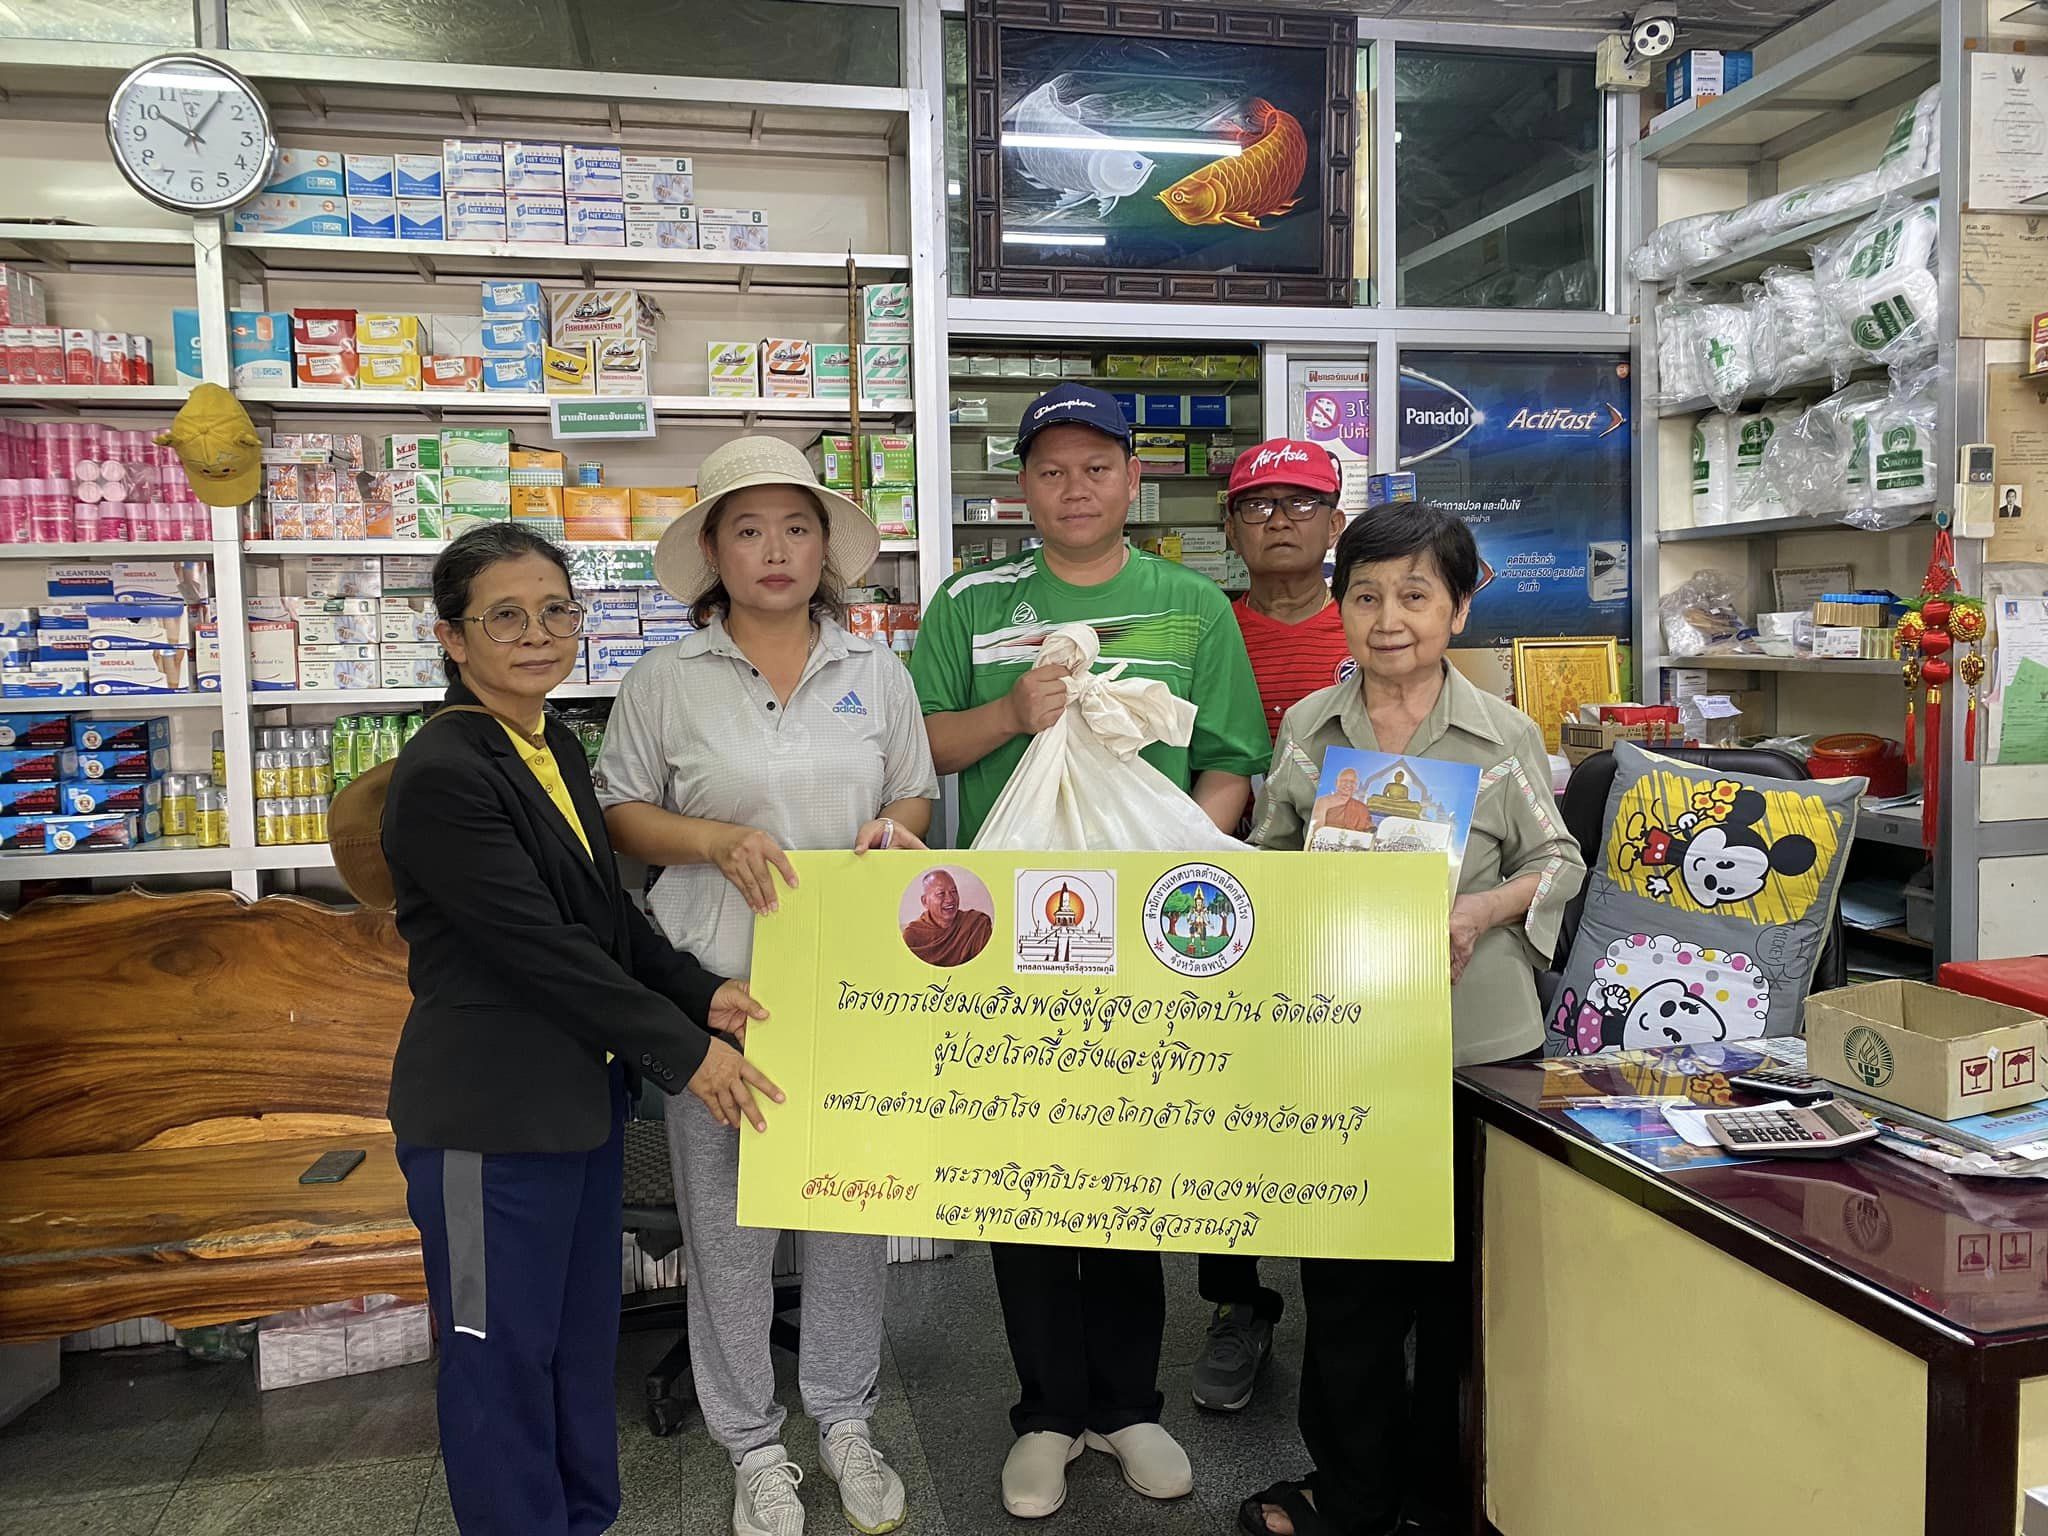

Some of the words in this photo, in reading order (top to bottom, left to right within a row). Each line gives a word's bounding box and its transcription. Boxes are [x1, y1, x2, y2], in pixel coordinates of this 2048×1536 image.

[139, 104, 161, 120] 10
[231, 105, 243, 121] 2
[133, 125, 147, 141] 9
[241, 131, 253, 147] 3
[142, 149, 154, 165] 8
[234, 154, 247, 169] 4
[163, 169, 175, 184] 7
[191, 177, 203, 192] 6
[217, 172, 229, 187] 5
[565, 322, 600, 332] FISHERMAN'S
[601, 323, 622, 332] FRIEND
[1033, 398, 1096, 420] Champion
[1346, 402, 1356, 418] 3
[1406, 408, 1468, 425] Panadol
[1508, 408, 1598, 430] ActiFast
[396, 443, 416, 456] M.16
[394, 478, 415, 491] M.16
[396, 514, 416, 526] M.16
[48, 634, 88, 642] KLEANTR
[832, 704, 868, 716] adidas
[1768, 928, 1790, 962] MICKEY
[1017, 962, 1114, 975] พุทธสถานลพบุรีศรีสุวรรณภูมิ
[1170, 954, 1228, 972] จังหวัดลพบุรี
[838, 976, 1265, 1036] โครงการเยี่ยมเสริมพลังผู้สูงอายุติดบ้าน
[1272, 992, 1362, 1025] ติดเตียง
[934, 1028, 1233, 1085] ผู้ป่วยโรคเรื้อรังและผู้พิการ
[824, 1090, 1040, 1121] เทศบาลตำบลโคกสำโรง
[1048, 1096, 1216, 1128] อำเภอโคกสำโรง
[1224, 1102, 1372, 1146] จังหวัดลพบุรี
[801, 1172, 920, 1212] สนับสนุนโดย
[935, 1162, 1162, 1200] พระราชวิสุทธิประชานาถ
[1171, 1172, 1368, 1206] (หลวงพ่ออลงกต)
